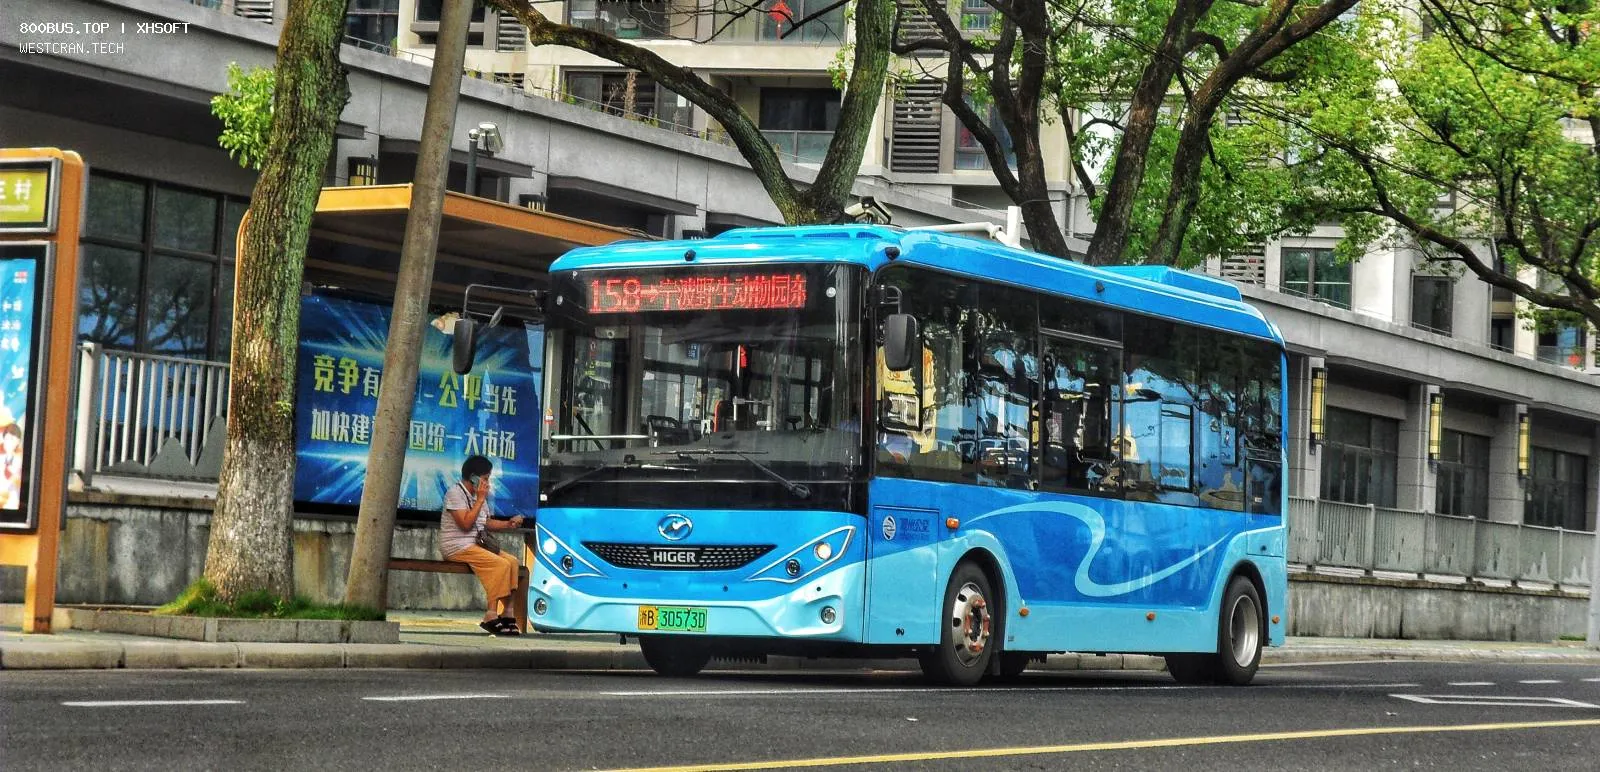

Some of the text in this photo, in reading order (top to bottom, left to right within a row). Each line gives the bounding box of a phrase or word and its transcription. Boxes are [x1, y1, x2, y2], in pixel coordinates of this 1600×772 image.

[588, 276, 641, 313] 158
[311, 408, 377, 445] 加快建
[653, 551, 696, 563] HIGER
